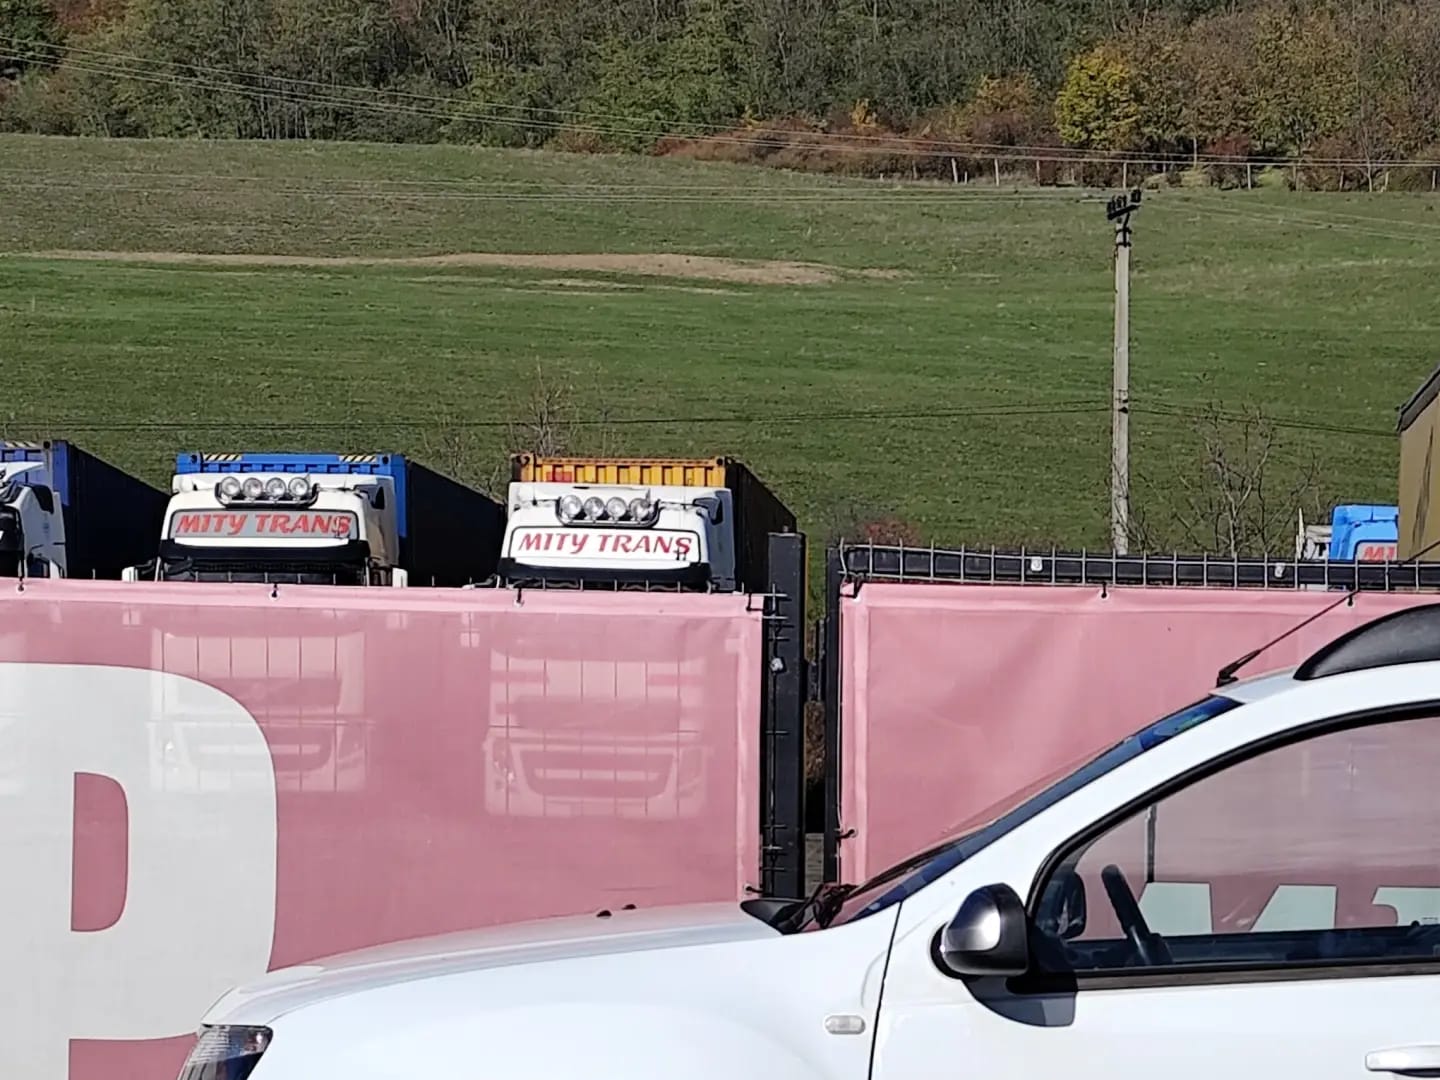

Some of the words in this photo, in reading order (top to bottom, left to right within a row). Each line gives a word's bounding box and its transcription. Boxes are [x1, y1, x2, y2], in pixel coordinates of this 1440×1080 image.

[176, 513, 248, 536] MITY
[254, 514, 352, 537] TRANS
[518, 532, 590, 555] MITY
[597, 533, 693, 555] TRANS
